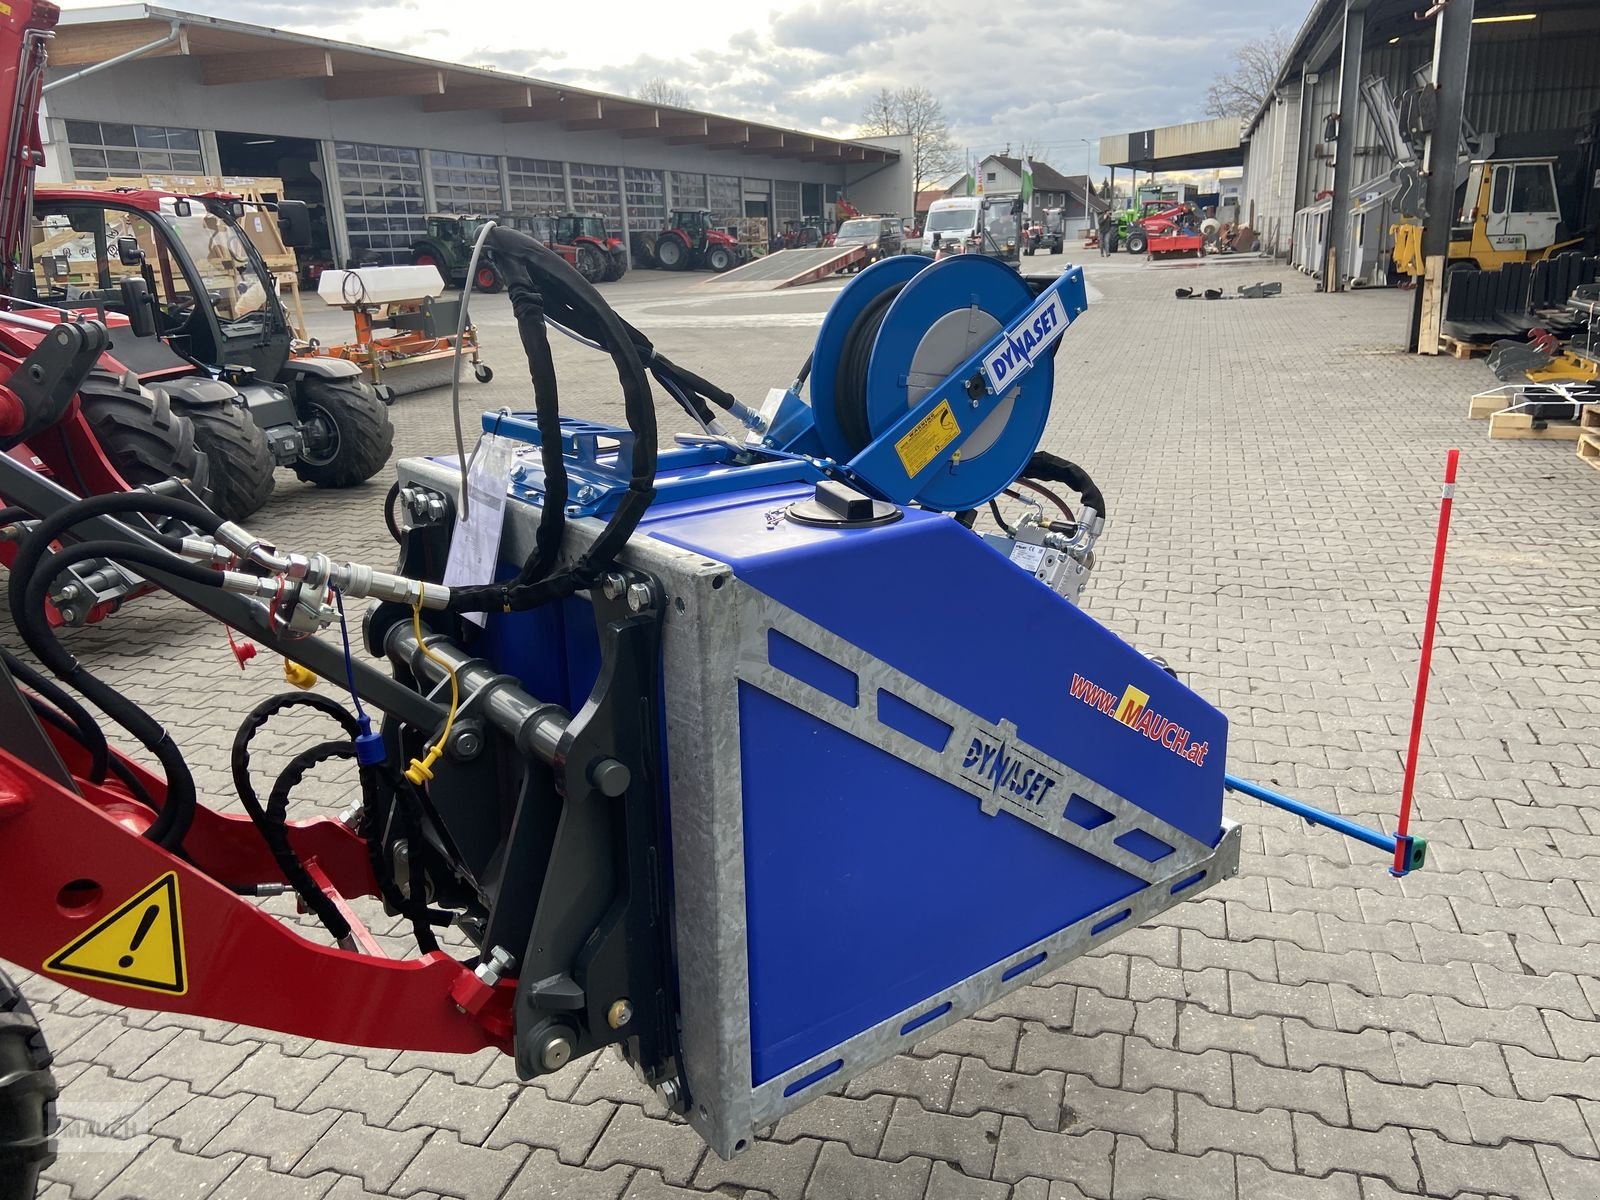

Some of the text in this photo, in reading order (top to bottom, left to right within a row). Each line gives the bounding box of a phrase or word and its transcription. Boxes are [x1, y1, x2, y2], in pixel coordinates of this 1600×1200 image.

[992, 302, 1057, 381] DYNASET
[1069, 673, 1209, 767] www.MAUCH.at
[962, 737, 1056, 805] DYNASET
